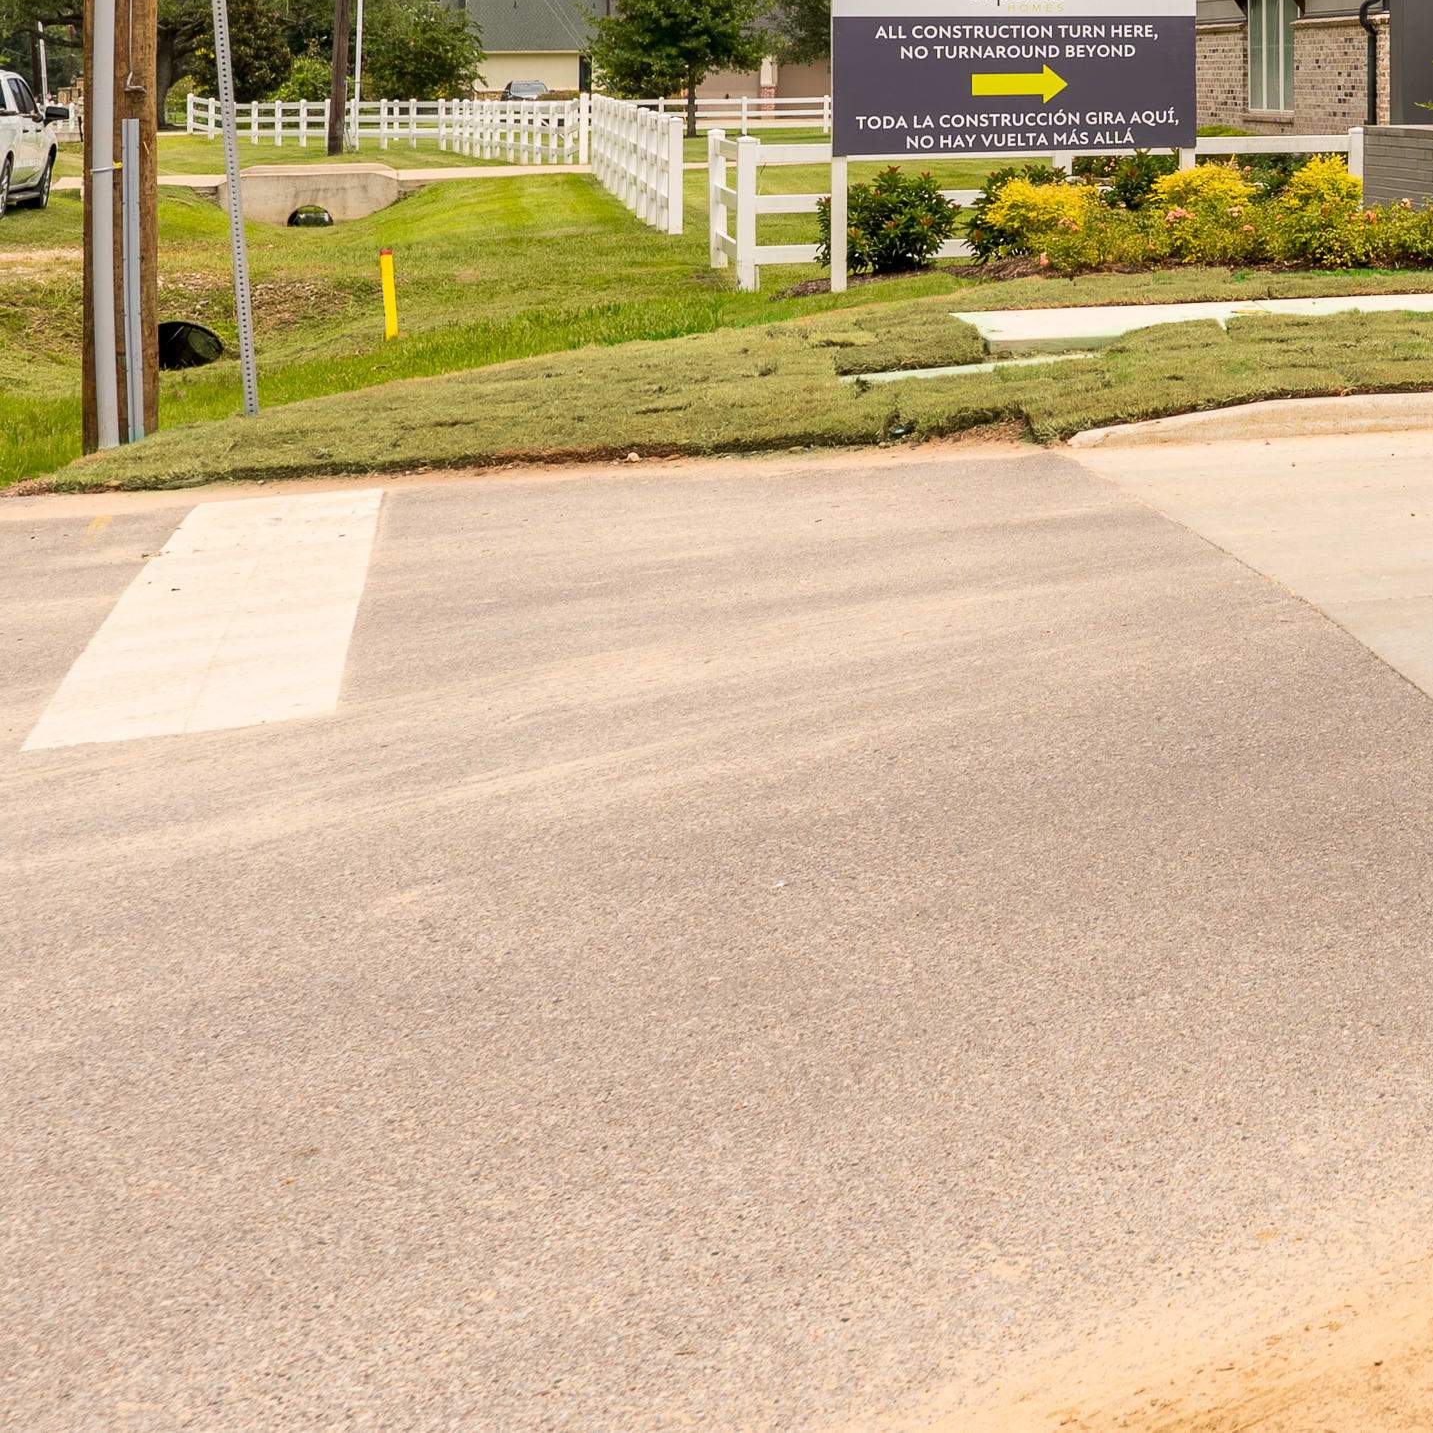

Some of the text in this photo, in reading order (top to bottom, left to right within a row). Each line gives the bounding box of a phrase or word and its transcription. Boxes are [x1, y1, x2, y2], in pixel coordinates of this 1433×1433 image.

[1007, 3, 1065, 13] HOMES
[875, 24, 1159, 41] ALL CONSTRUCTION TURN HERE,
[900, 44, 1136, 60] NO TURNAROUND BEYOND
[855, 106, 1179, 130] TODA LA CONSTRUCCIÓN GIRA AQUÍ,
[906, 126, 1135, 150] NO HAY VUELTA MÁS ALLÁ
